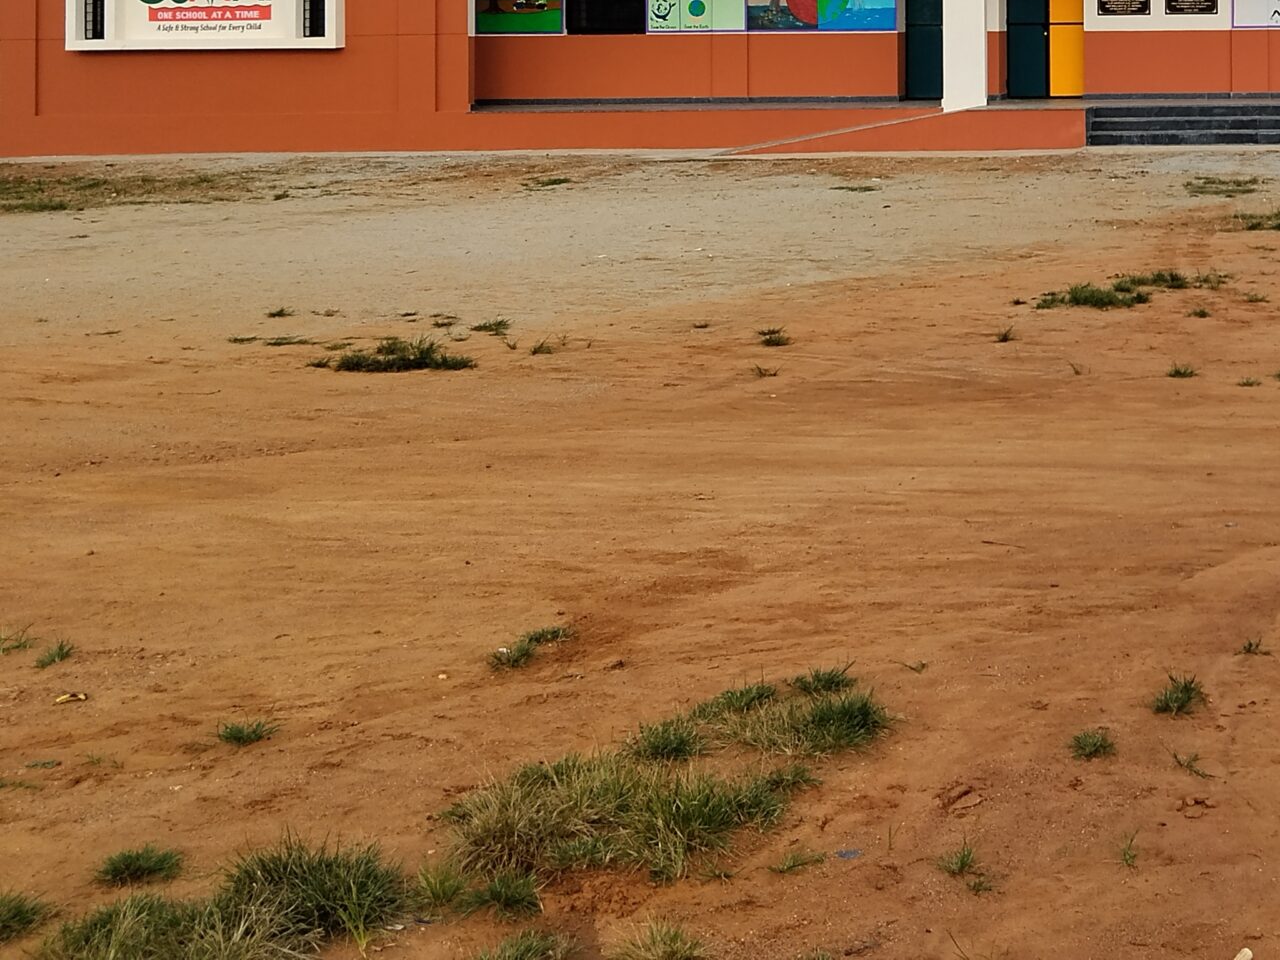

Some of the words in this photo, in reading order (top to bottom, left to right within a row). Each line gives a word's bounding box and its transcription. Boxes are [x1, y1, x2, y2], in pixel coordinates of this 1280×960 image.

[157, 11, 173, 19] ONE
[175, 11, 208, 19] SCHOOL
[211, 11, 223, 19] AT
[224, 11, 232, 19] A
[234, 10, 260, 18] TIME
[162, 24, 174, 32] Safe
[181, 24, 199, 33] Strong
[200, 23, 218, 31] School
[218, 23, 227, 32] for
[228, 23, 245, 33] Every
